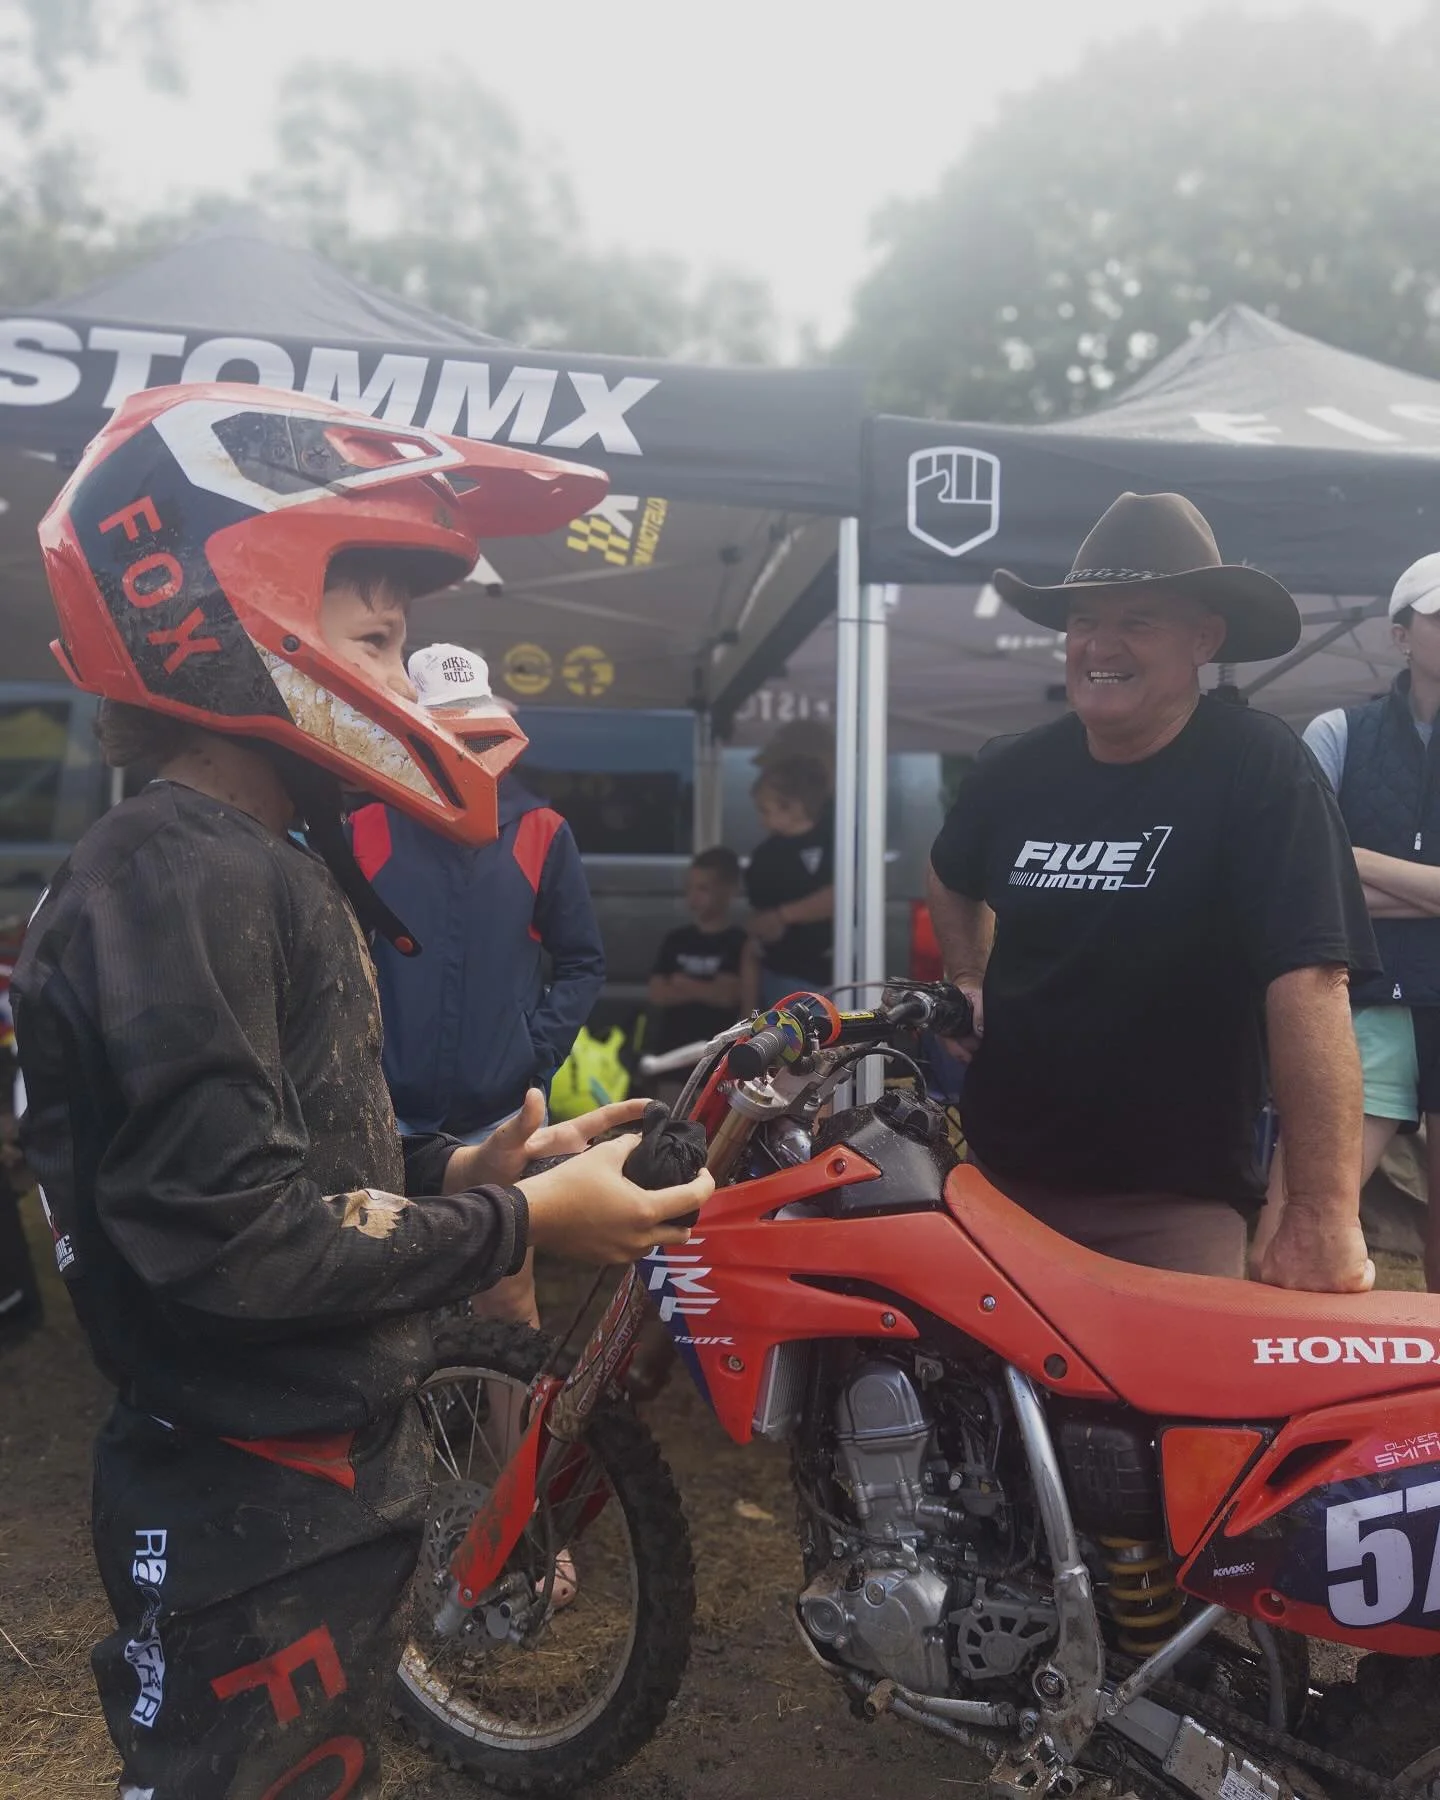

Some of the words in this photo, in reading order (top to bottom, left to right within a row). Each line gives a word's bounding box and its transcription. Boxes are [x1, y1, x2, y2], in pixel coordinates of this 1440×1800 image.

[99, 496, 221, 675] FOX
[442, 656, 471, 671] BIKES
[444, 671, 475, 682] BULLS
[1014, 840, 1143, 871] FIVE
[1044, 873, 1124, 890] MOTO
[674, 1335, 737, 1345] 150R
[1252, 1336, 1440, 1364] HOND
[1384, 1432, 1439, 1451] OLIVER
[1374, 1441, 1440, 1468] SMIT
[1213, 1563, 1246, 1577] KMX
